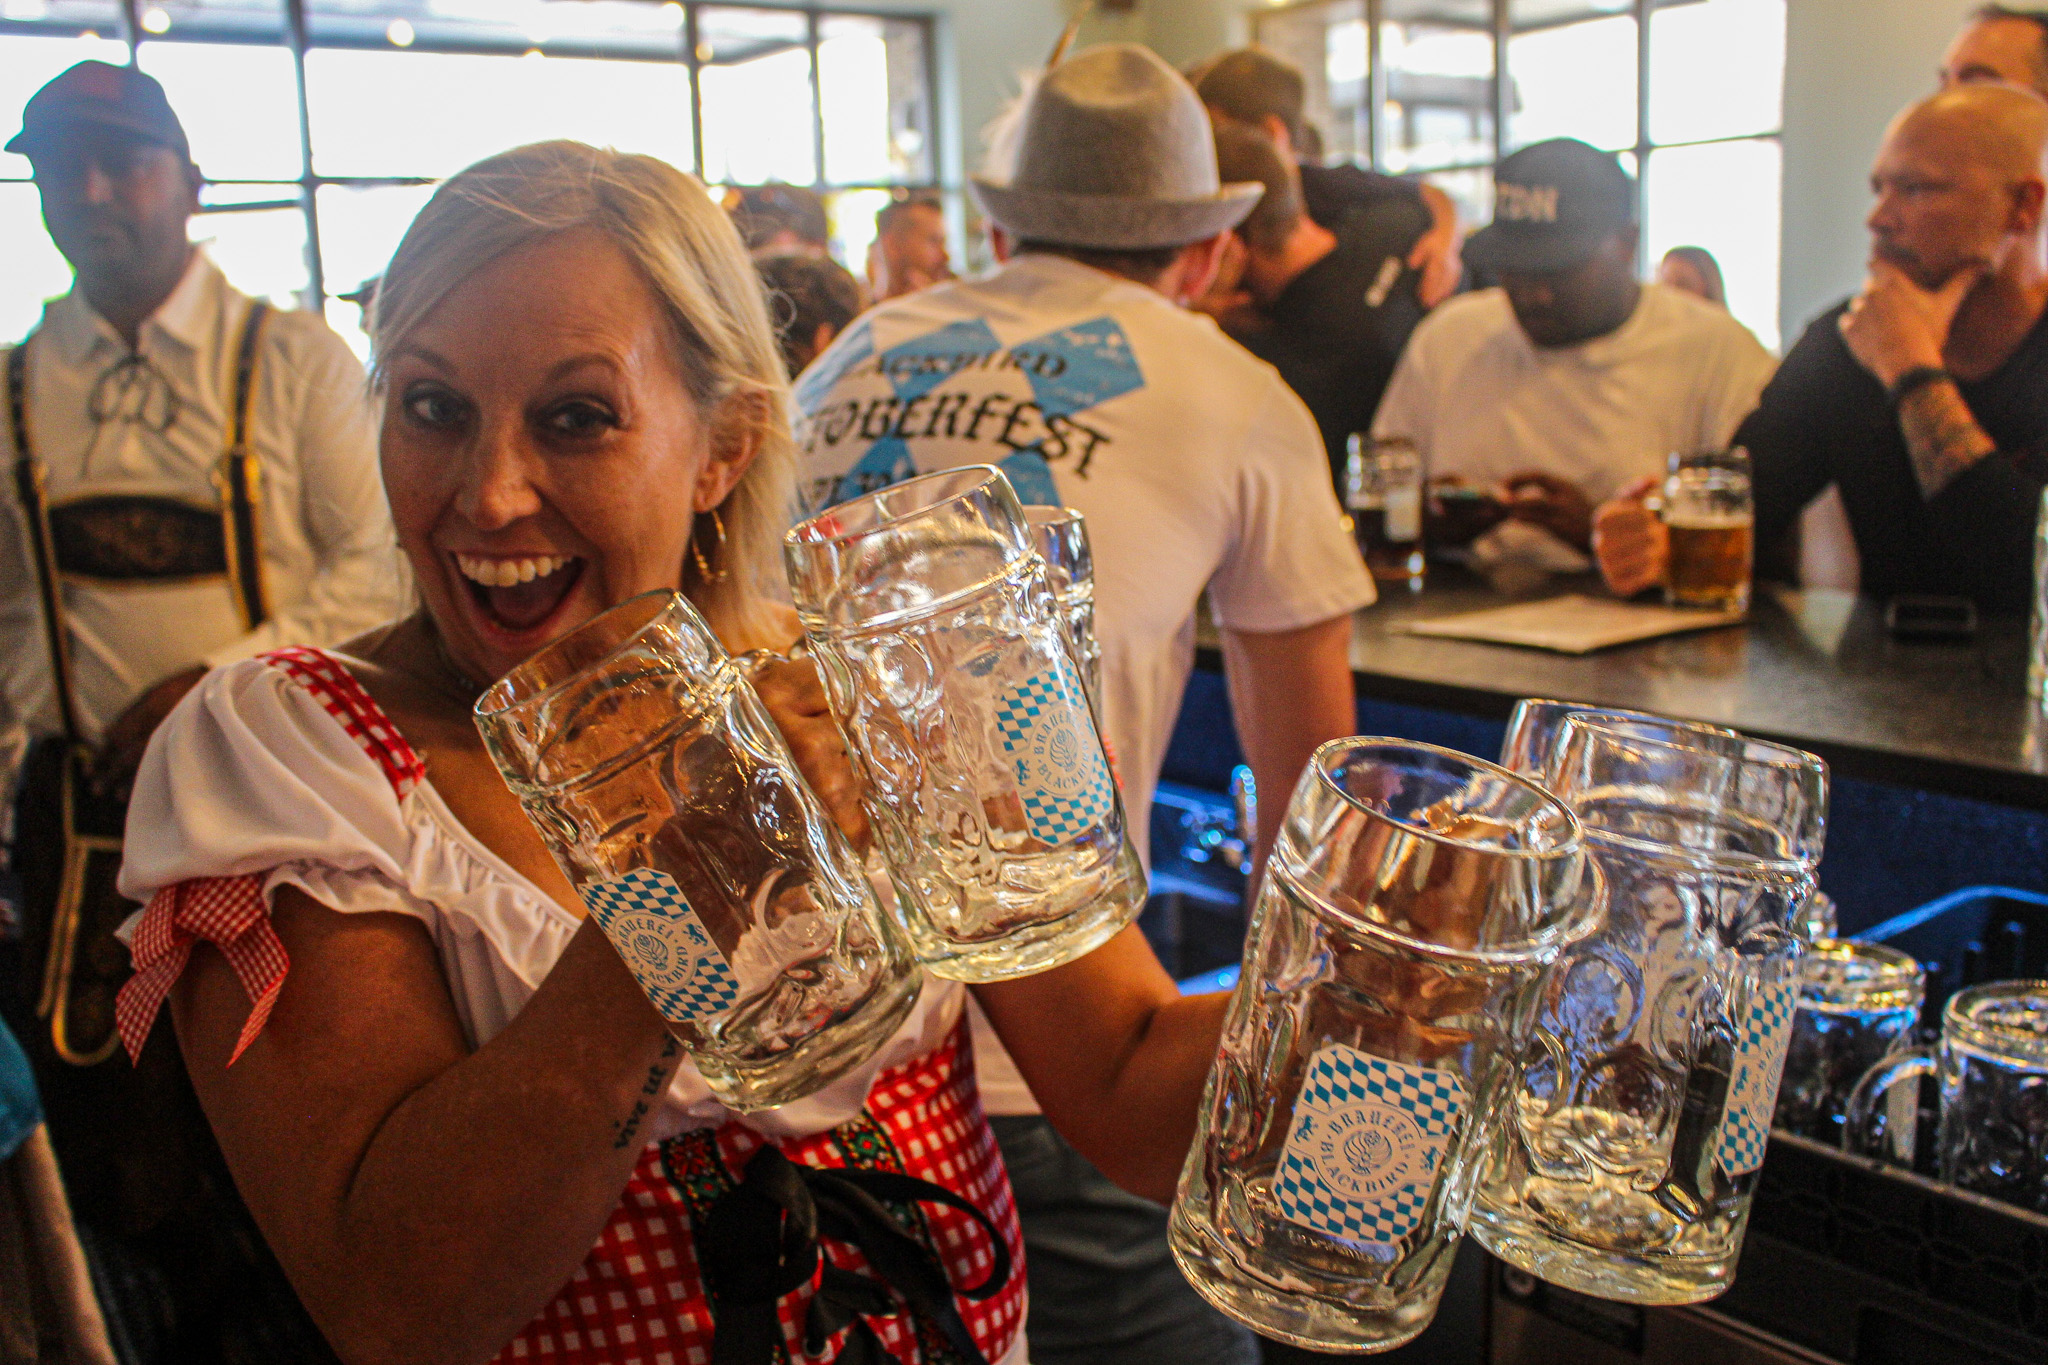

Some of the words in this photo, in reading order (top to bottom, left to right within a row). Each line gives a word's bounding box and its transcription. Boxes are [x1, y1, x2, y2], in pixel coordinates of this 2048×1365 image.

[800, 392, 1111, 480] TOBERFEST
[1328, 1109, 1416, 1151] BRAUEREI
[1319, 1140, 1409, 1193] BLACKBIRD
